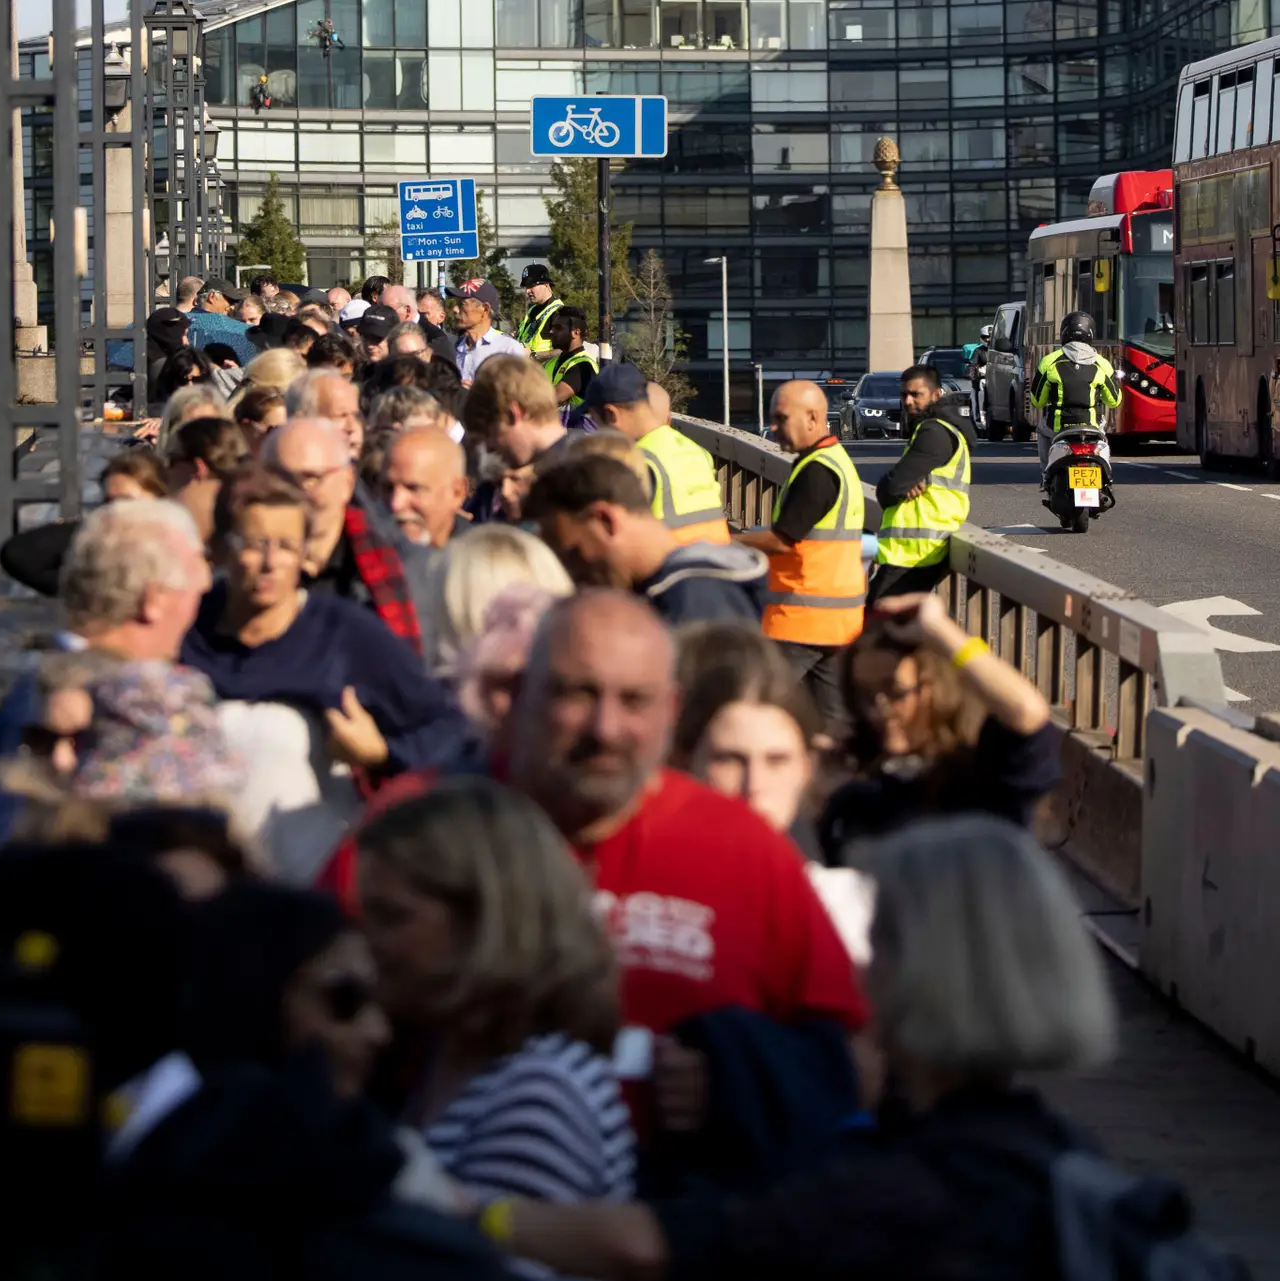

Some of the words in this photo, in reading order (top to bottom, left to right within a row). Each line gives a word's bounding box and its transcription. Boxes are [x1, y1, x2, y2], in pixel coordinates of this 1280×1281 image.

[406, 222, 424, 231] taxi
[418, 237, 438, 246] Mon
[444, 236, 462, 245] Sun
[415, 248, 425, 257] at
[427, 248, 443, 258] any
[445, 246, 465, 255] time
[1073, 469, 1098, 478] PE71
[1075, 478, 1097, 487] FLK
